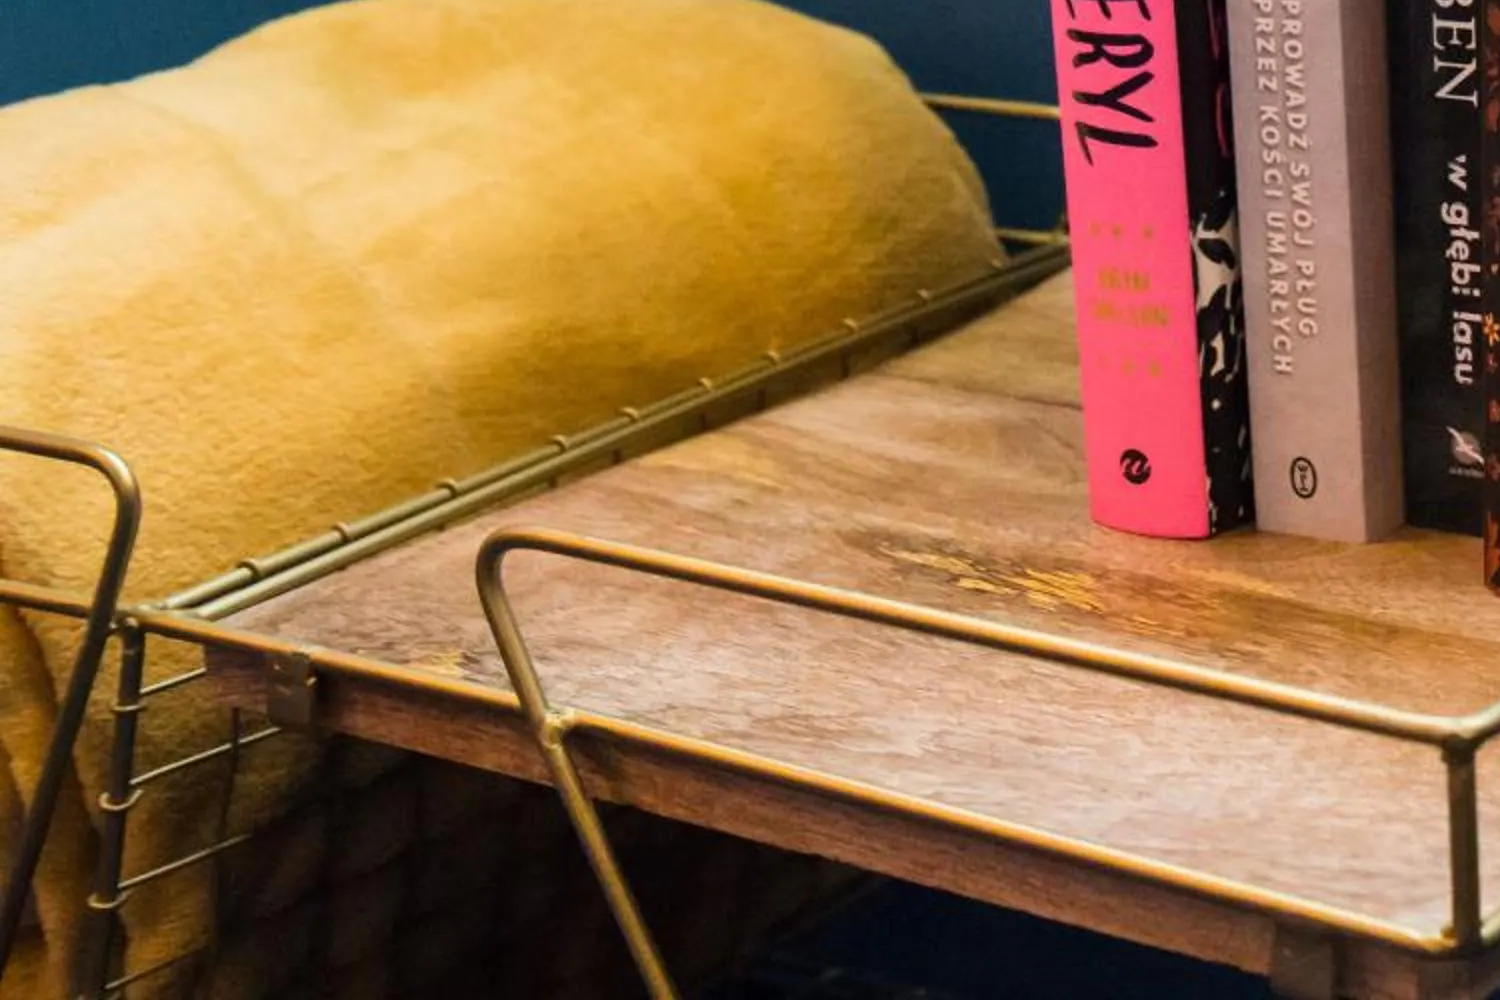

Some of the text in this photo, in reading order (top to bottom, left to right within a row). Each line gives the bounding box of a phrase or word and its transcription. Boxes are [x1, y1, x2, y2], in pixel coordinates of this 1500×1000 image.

[1258, 104, 1287, 198] KOŚCI
[1288, 161, 1317, 246] SWÓJ
[1265, 210, 1294, 374] UMARŁYCH
[1440, 201, 1482, 298] głębi
[1295, 259, 1318, 337] PŁUG
[1452, 311, 1483, 386] lasu
